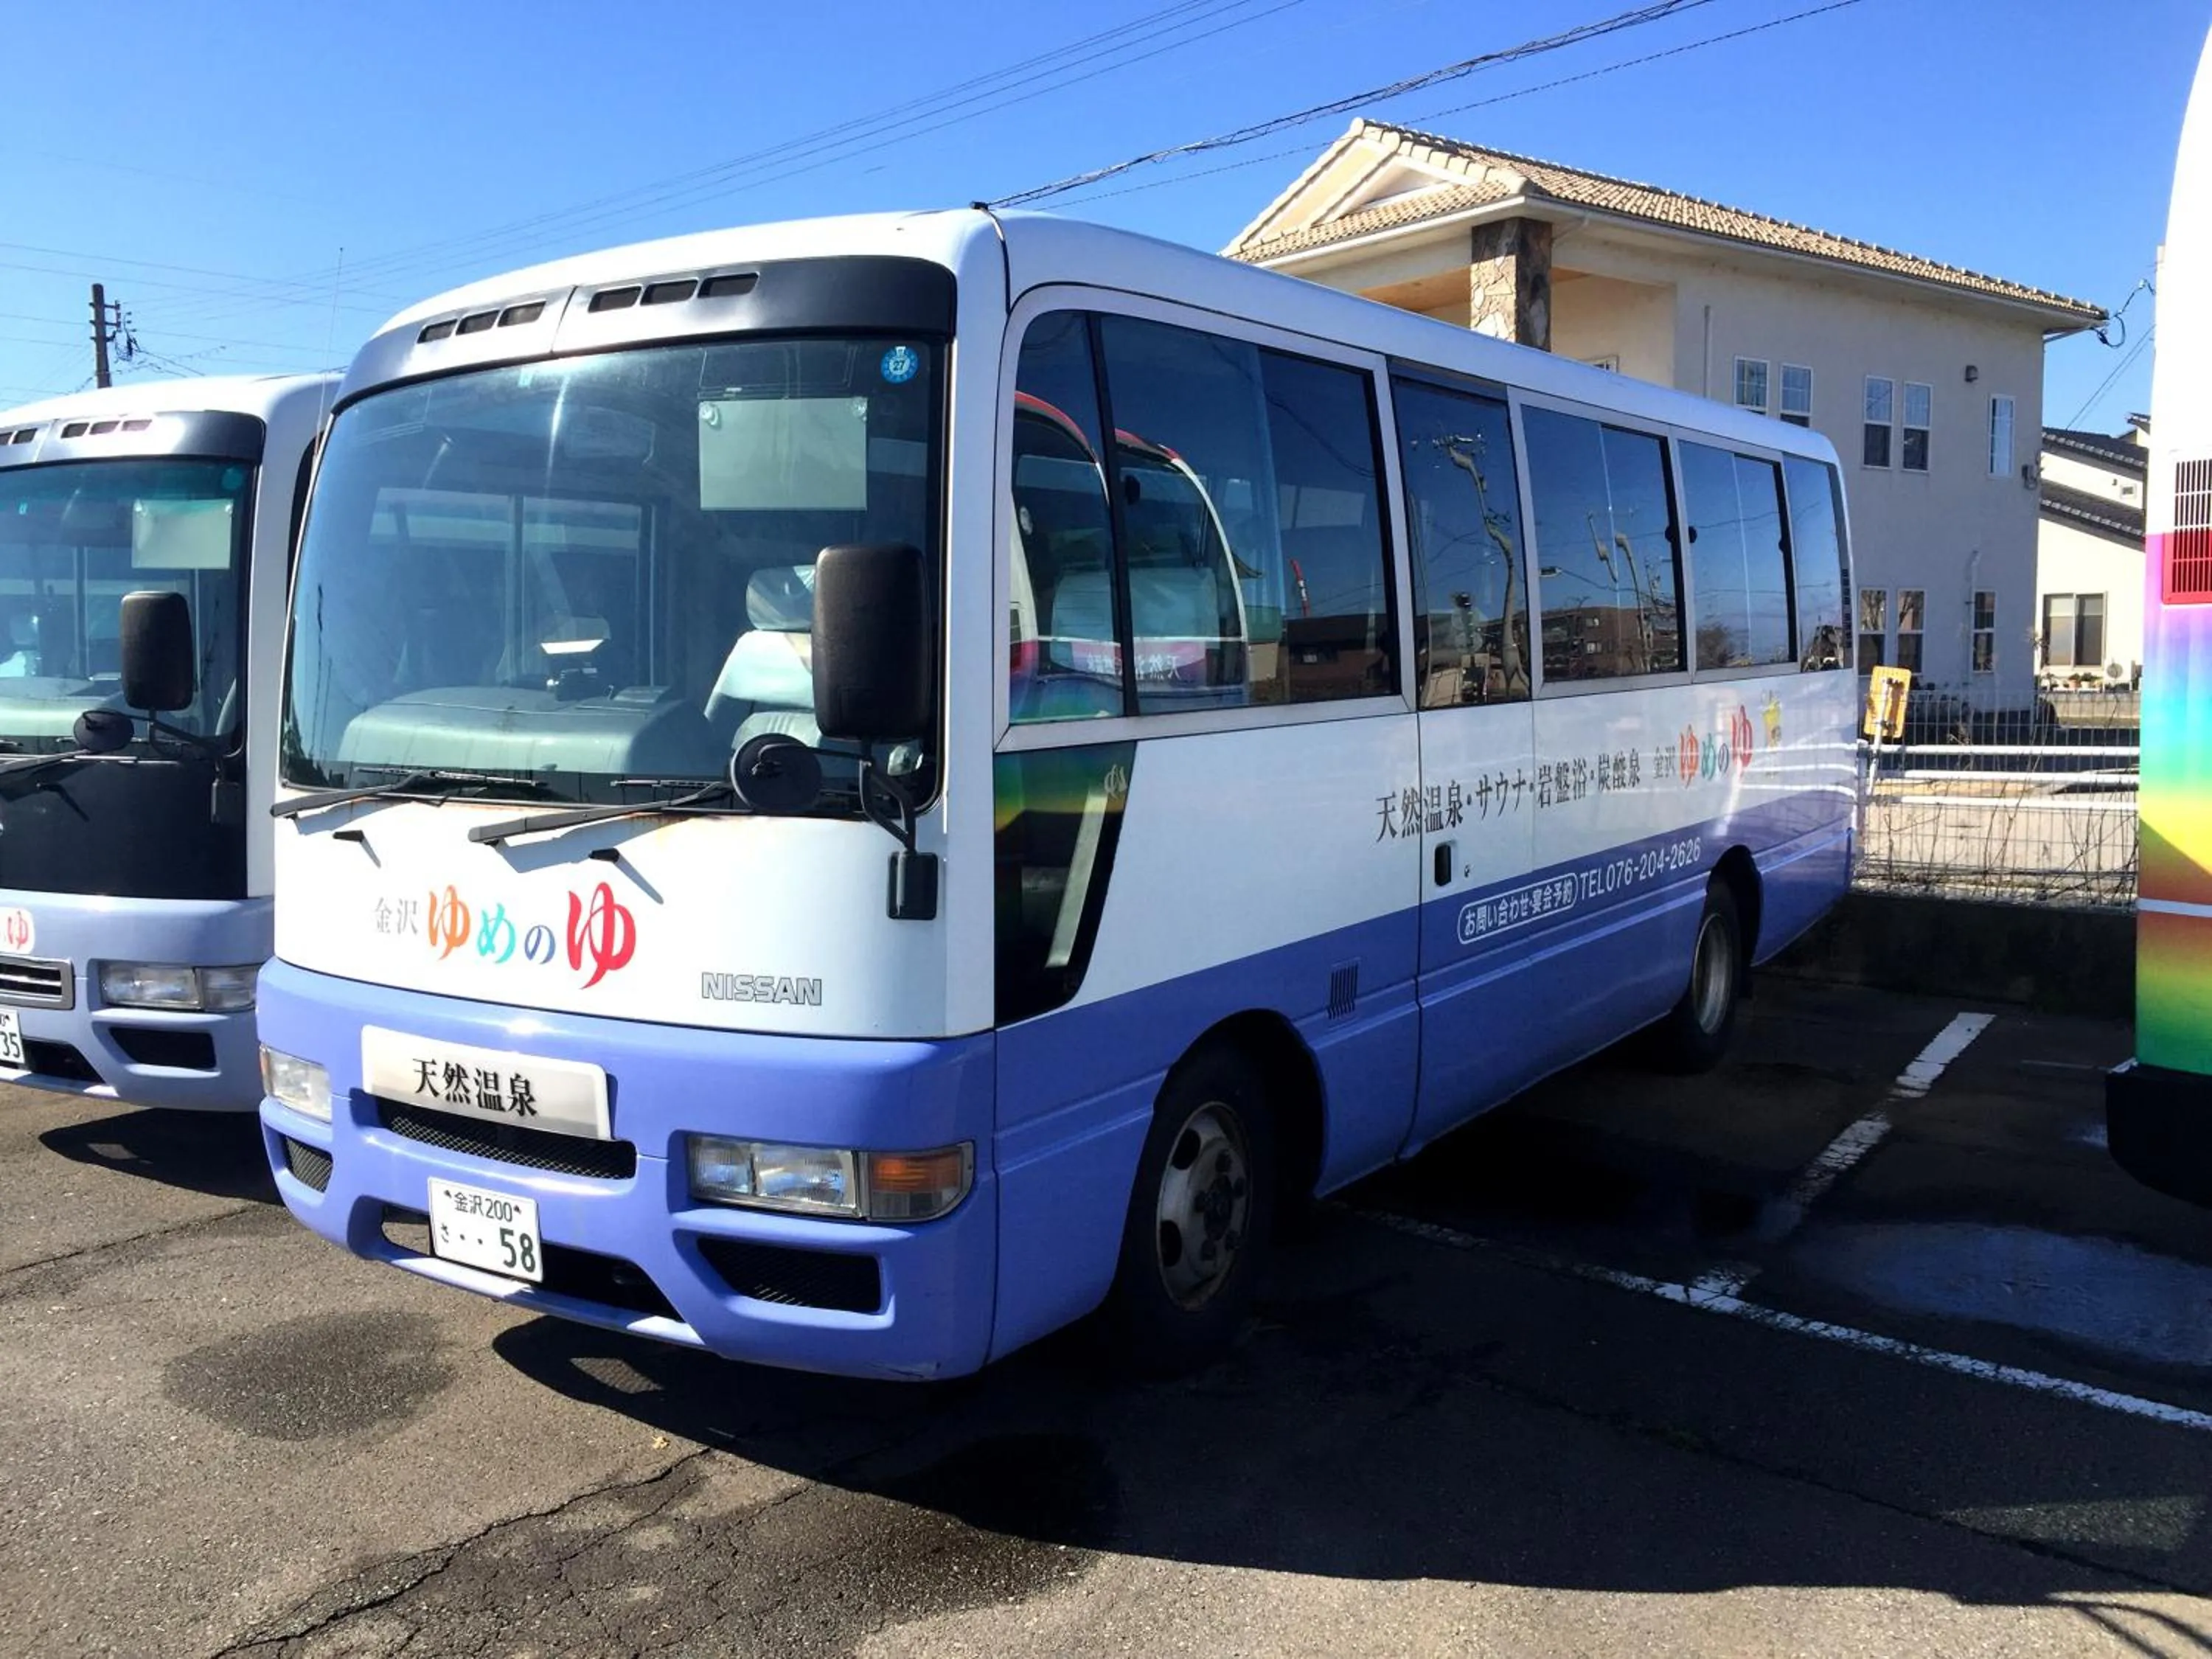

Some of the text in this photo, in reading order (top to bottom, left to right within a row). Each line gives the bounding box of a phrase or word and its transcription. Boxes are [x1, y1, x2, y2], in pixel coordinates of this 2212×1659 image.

[428, 881, 637, 990] ゆめのゆ
[702, 972, 822, 1006] NISSAN
[413, 1058, 538, 1116] 天然温泉
